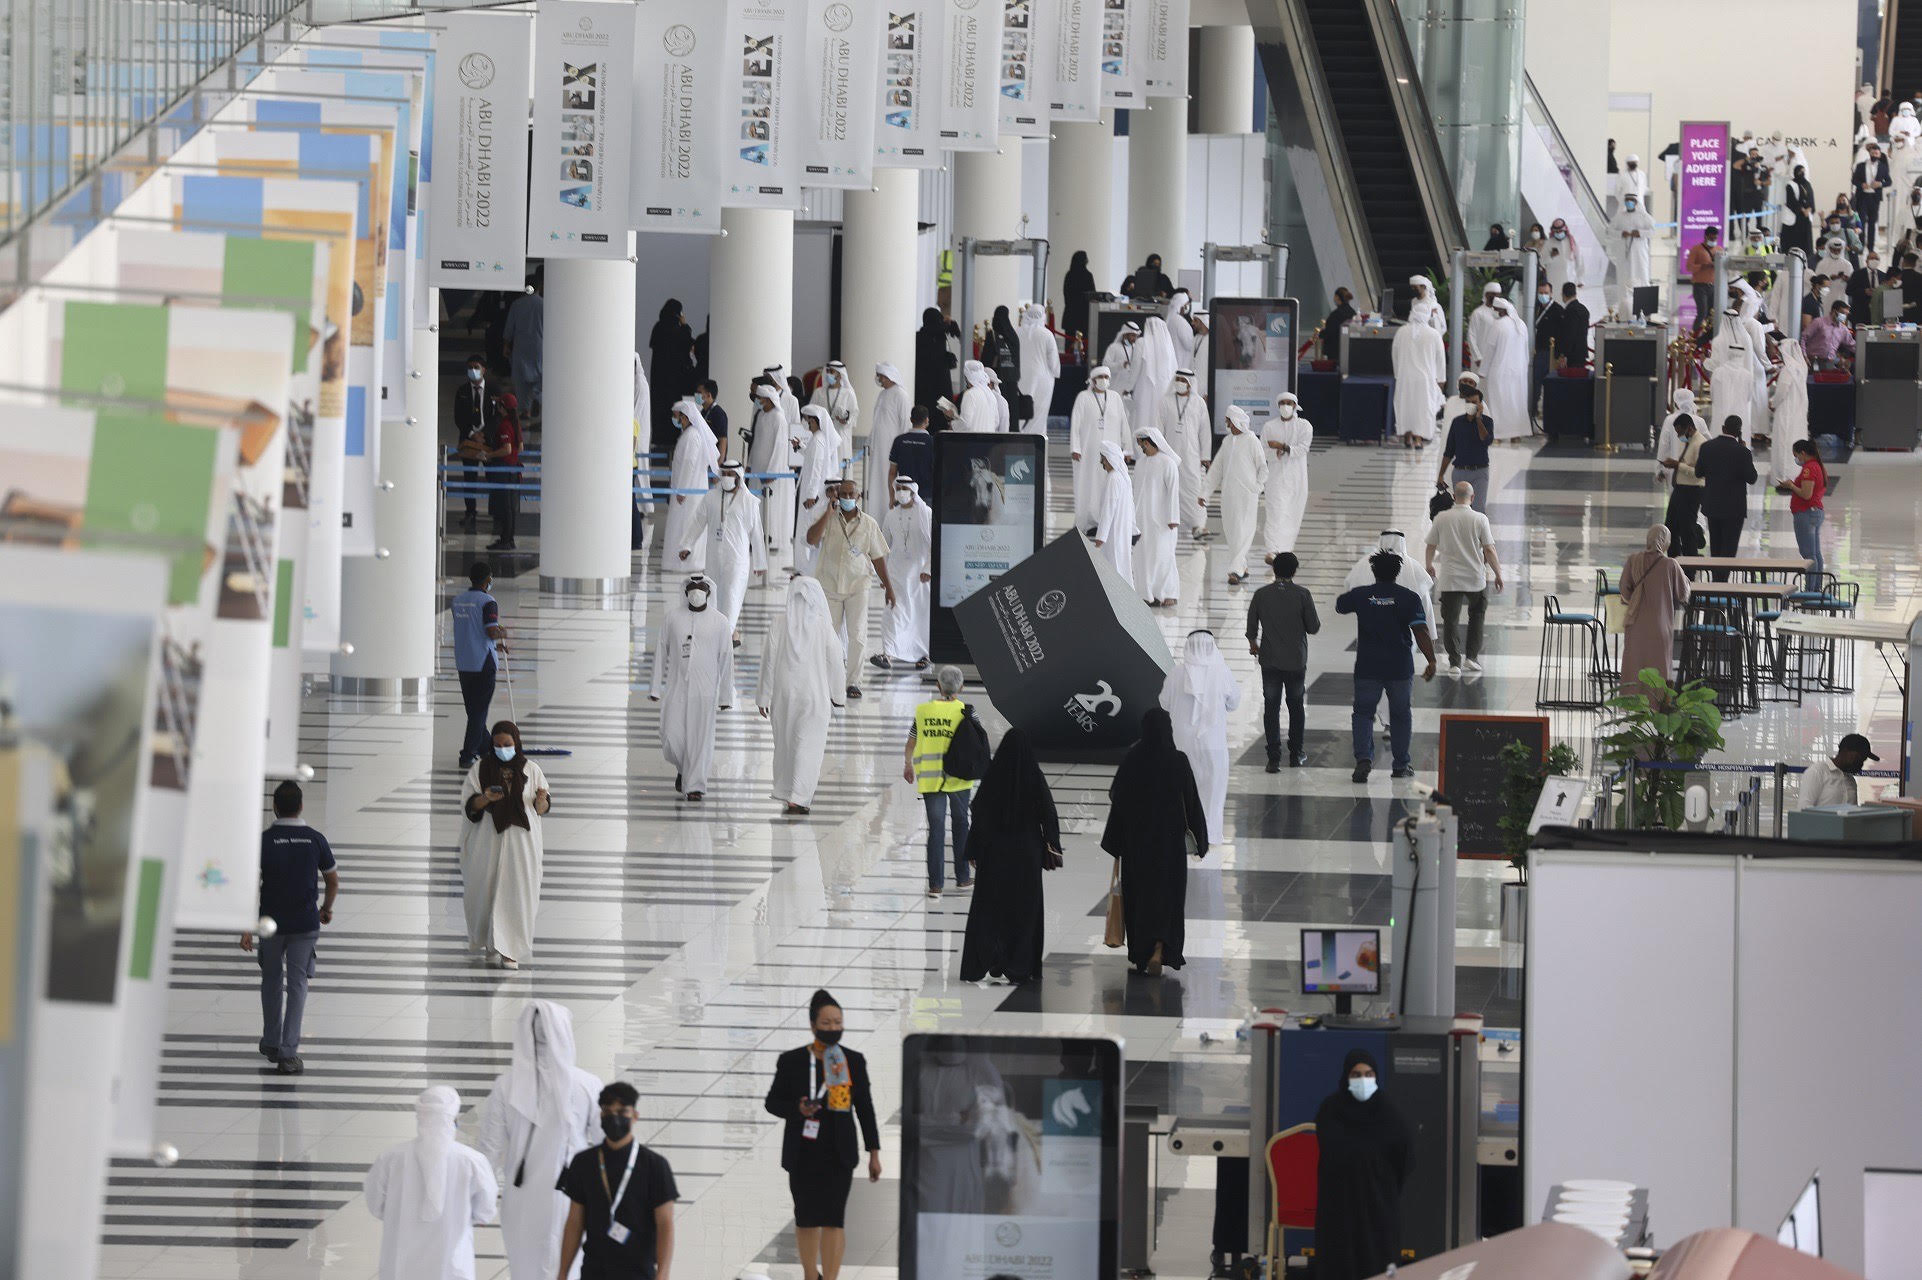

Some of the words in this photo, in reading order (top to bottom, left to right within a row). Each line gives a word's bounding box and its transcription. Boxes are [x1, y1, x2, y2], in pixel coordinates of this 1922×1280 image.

[966, 15, 977, 40] ABU
[1069, 22, 1081, 57] DHABI
[839, 38, 849, 65] ABU
[965, 41, 976, 79] DHABI
[681, 64, 693, 94] ABU
[885, 11, 915, 129] ADIHEX
[1068, 58, 1079, 82] 2022
[740, 34, 774, 166] ADIHEX
[837, 68, 849, 108] DHABI
[963, 81, 975, 109] 2022
[478, 97, 492, 131] ABU
[679, 97, 692, 142] DHABI
[834, 111, 847, 141] 2022
[560, 61, 597, 211] ADIHEX
[1690, 139, 1720, 148] PLACE
[1756, 136, 1779, 147] CA
[1785, 137, 1818, 147] PARK
[477, 135, 492, 187] DHABI
[678, 145, 691, 179] 2022
[1685, 164, 1724, 174] ADVERT
[1691, 152, 1718, 161] YOUR
[1691, 177, 1717, 187] HERE
[476, 190, 490, 228] 2022
[1002, 585, 1021, 607] ABU
[1012, 603, 1036, 640] DHABI
[1026, 635, 1045, 664] 2022
[924, 718, 952, 727] TEAM
[1063, 697, 1098, 732] YEARS
